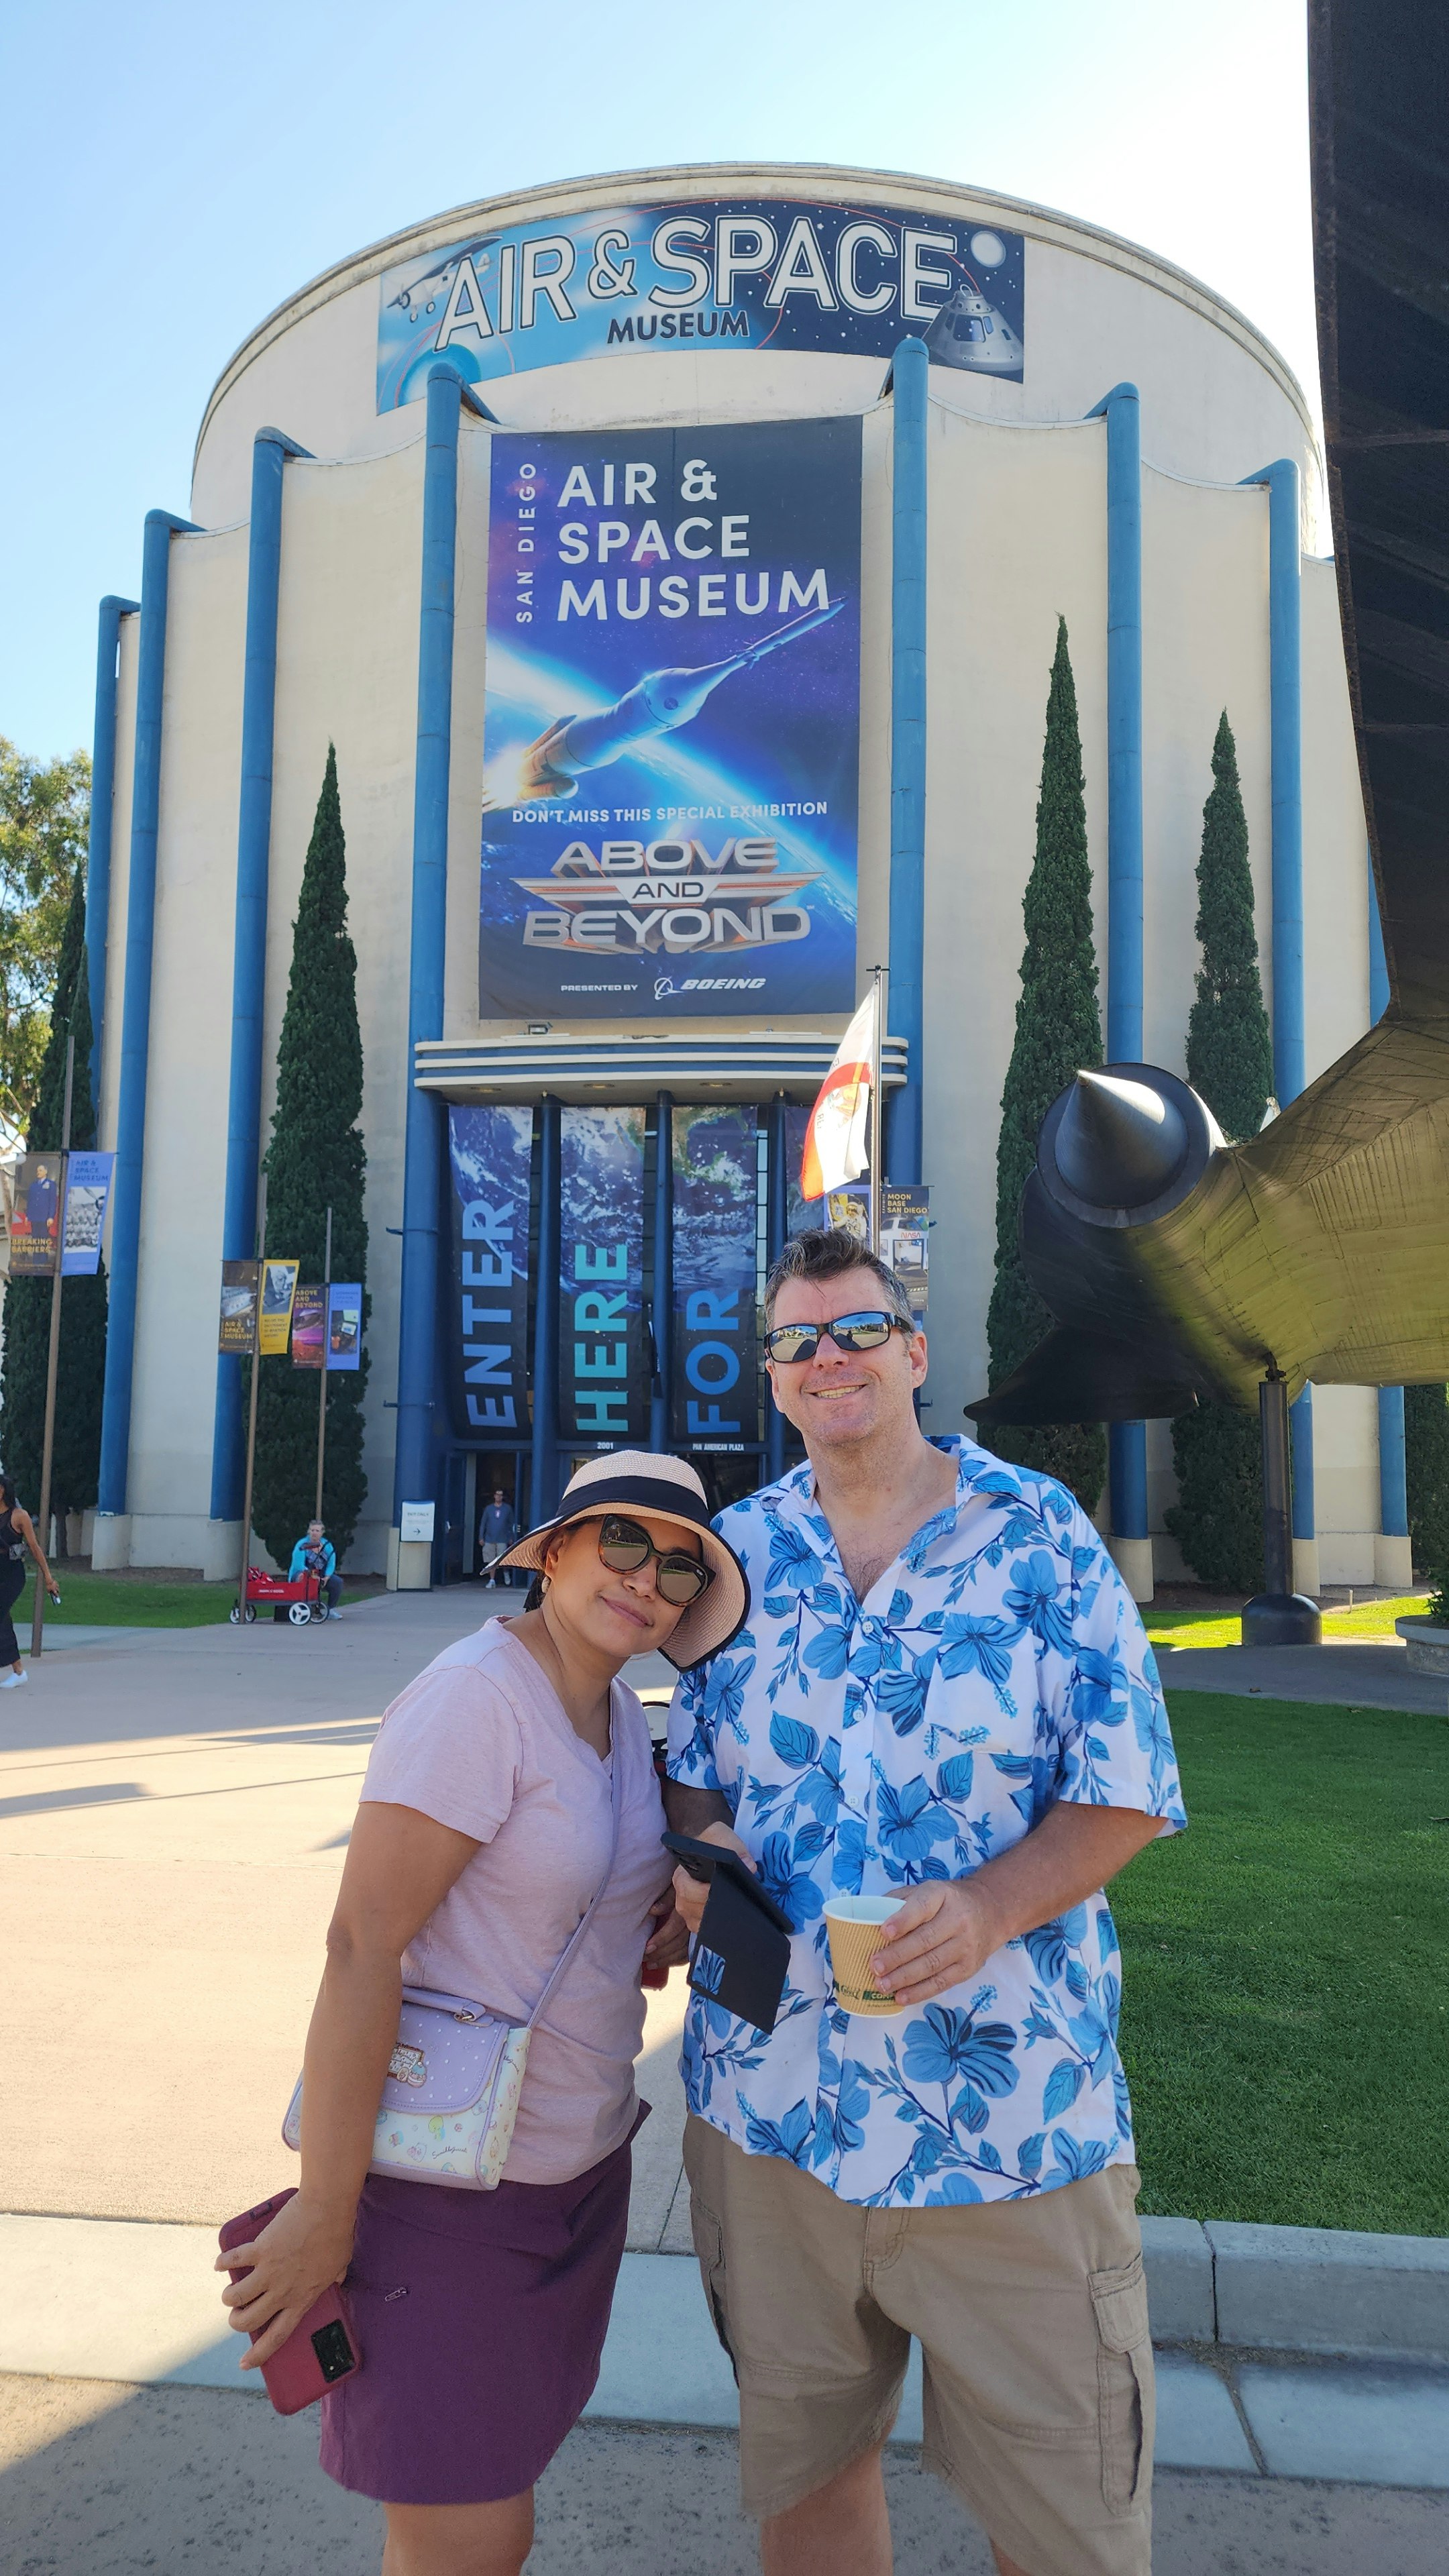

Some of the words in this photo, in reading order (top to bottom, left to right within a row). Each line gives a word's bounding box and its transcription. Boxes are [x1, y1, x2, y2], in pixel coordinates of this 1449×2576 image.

[433, 234, 577, 353] AIR
[586, 229, 637, 301] &
[647, 215, 958, 320] SPACE
[606, 309, 749, 345] MUSEUM
[557, 463, 657, 507] AIR
[680, 459, 718, 502] &
[517, 463, 537, 553] DIEGO
[557, 515, 750, 564] SPACE
[516, 571, 533, 623] SAN
[557, 568, 830, 622] MUSEUM
[512, 809, 564, 823] DON'T
[568, 808, 610, 822] MISS
[614, 808, 651, 822] THIS
[655, 806, 726, 820] SPECIAL
[730, 801, 828, 818] EXHIBITION
[550, 837, 778, 877] ABOVE
[631, 881, 704, 899] AND
[522, 906, 810, 951] BEYOND
[680, 978, 767, 990] BOEING
[462, 1199, 517, 1428] ENTER
[574, 1244, 629, 1432] HERE
[684, 1290, 741, 1434] FOR
[704, 1443, 727, 1451] AMERICAN
